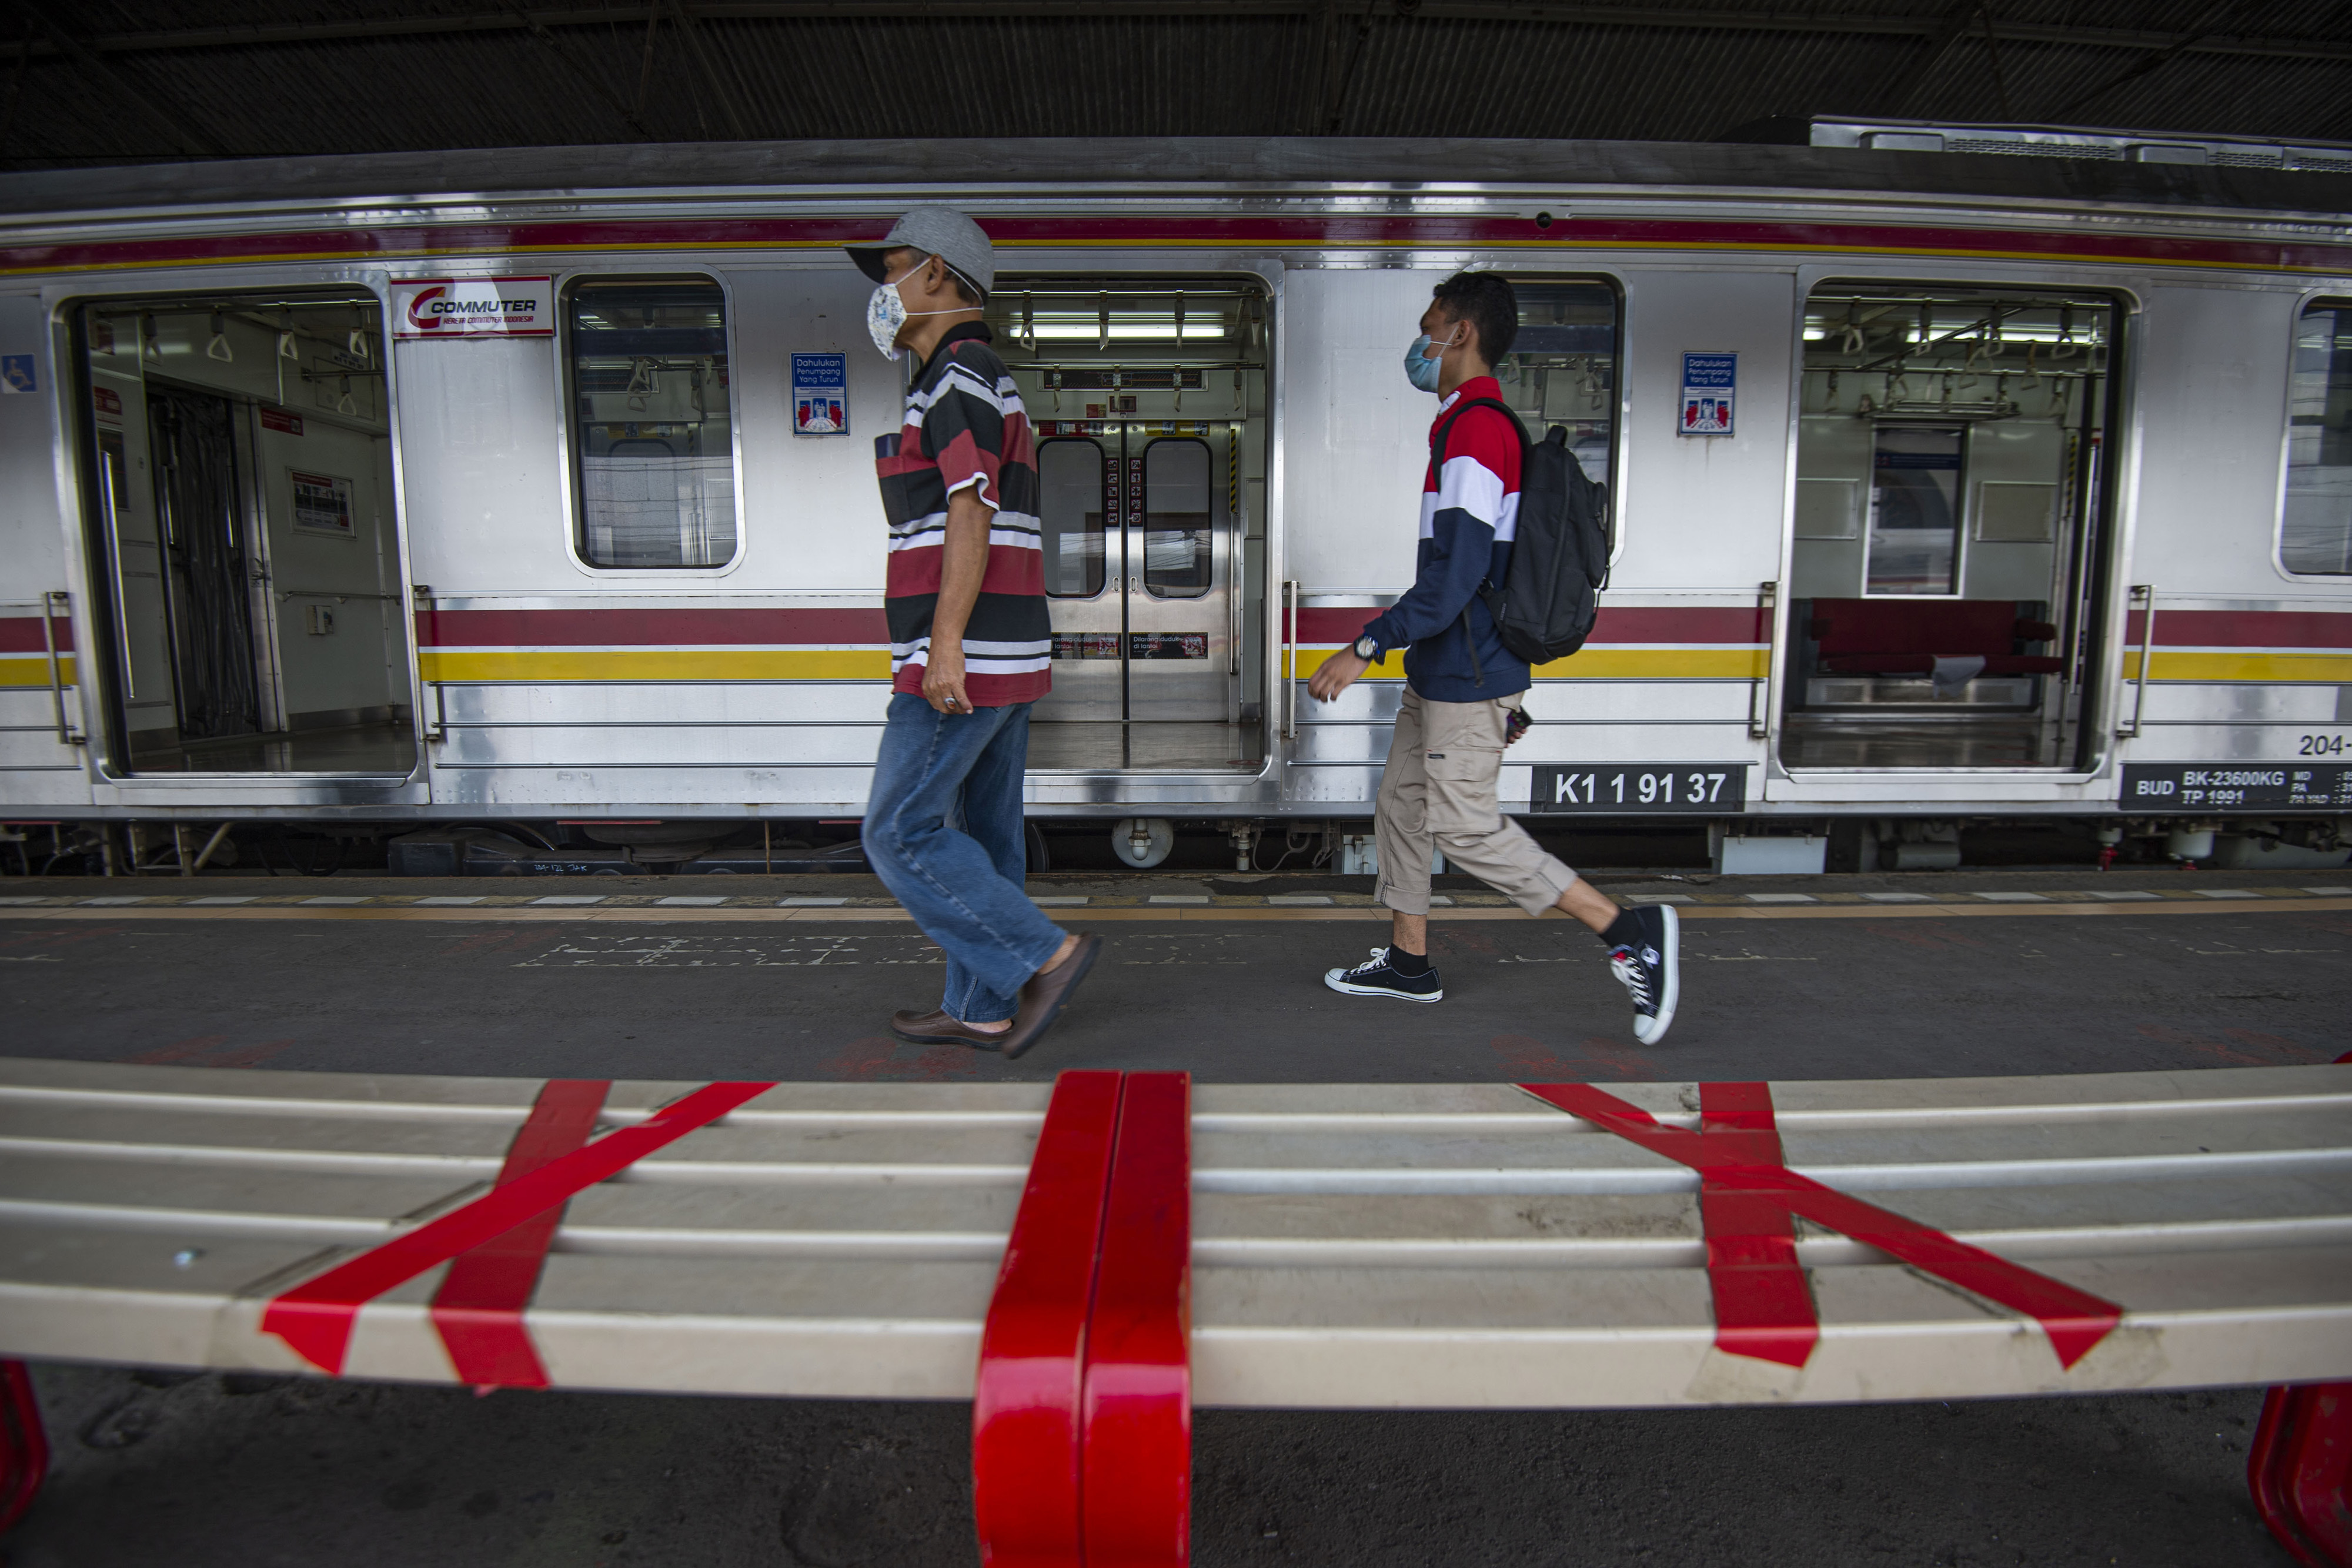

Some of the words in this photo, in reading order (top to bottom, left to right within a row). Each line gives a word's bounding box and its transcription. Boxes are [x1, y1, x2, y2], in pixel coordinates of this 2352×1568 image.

[432, 300, 537, 313] COMMUTER
[797, 359, 840, 367] Dahulukan
[1688, 368, 1732, 376] Penumpang
[2181, 771, 2286, 786] BK-23600KG
[1555, 773, 1595, 803] K1
[1611, 773, 1625, 803] 1
[1639, 773, 1673, 803] 91
[1687, 773, 1726, 803] 37
[2136, 780, 2175, 795] BUD
[2290, 783, 2308, 792] PA
[2181, 790, 2204, 804] TP
[2207, 790, 2244, 804] 1991
